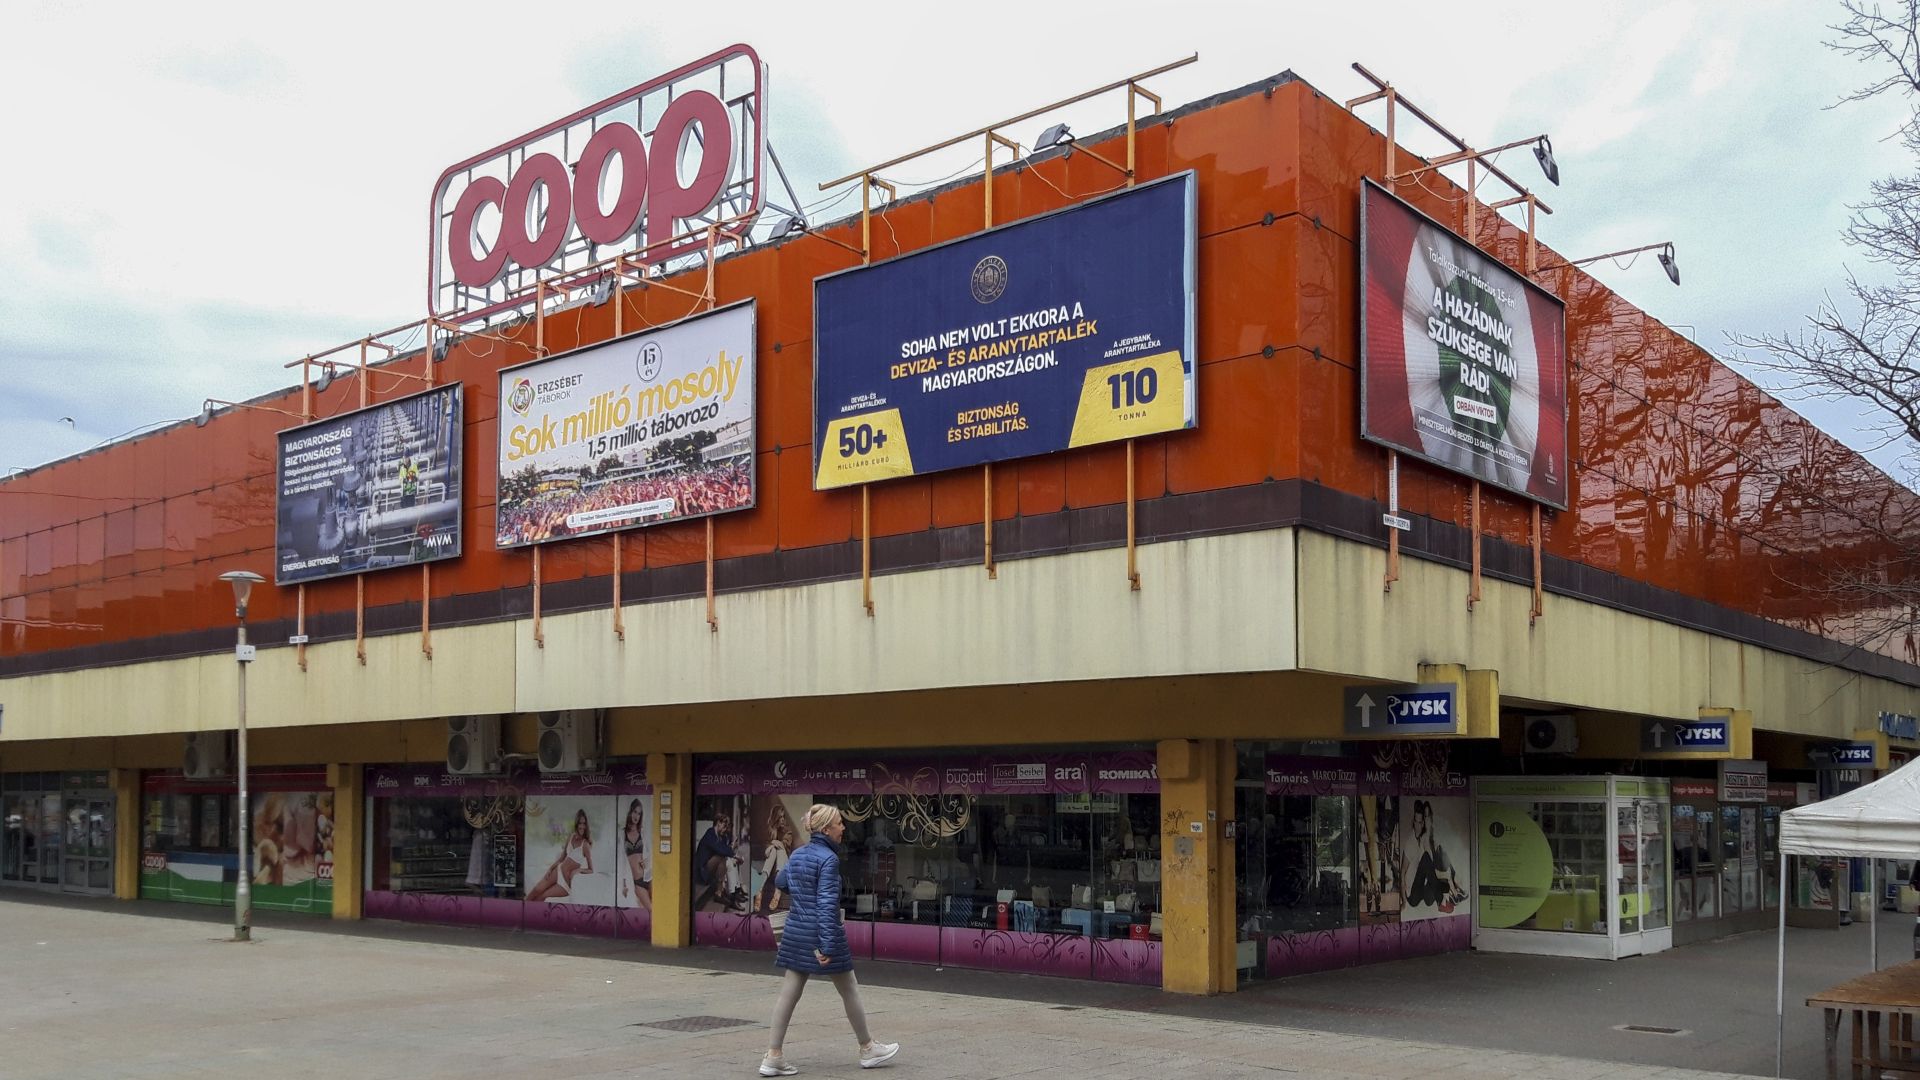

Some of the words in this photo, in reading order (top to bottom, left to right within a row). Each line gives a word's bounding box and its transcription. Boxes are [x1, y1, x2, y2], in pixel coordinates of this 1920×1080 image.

[448, 89, 735, 289] coop
[1471, 274, 1496, 297] március
[1432, 286, 1443, 311] A
[1445, 291, 1513, 348] HAZÁDNAK
[901, 338, 937, 358] SOHA
[940, 327, 969, 350] NEM
[971, 319, 1007, 342] VOLT
[1010, 305, 1069, 334] EKKORA
[1072, 301, 1084, 320] A
[1119, 333, 1152, 347] JEGYBANK
[643, 348, 656, 365] 15
[890, 359, 943, 380] DEVIZA-
[948, 349, 965, 368] ÉS
[968, 319, 1098, 363] ARANYTARTALÉK
[1103, 339, 1161, 358] ARANYTARTALÉKA
[1427, 316, 1492, 367] SZÜKSÉGE
[1493, 348, 1518, 381] VAN
[922, 350, 1059, 394] MAGYARORSZÁGON.
[1460, 361, 1490, 395] RÁD!
[537, 373, 583, 395] ERZSÉBET
[1107, 367, 1158, 410] 110
[507, 413, 557, 461] Sok
[562, 383, 632, 446] millió
[637, 350, 743, 420] mosoly
[537, 390, 571, 406] TÁBOROK
[957, 401, 1020, 425] BIZTONSÁG
[1118, 410, 1147, 421] TONNA
[1456, 400, 1476, 414] ORBÁN
[1475, 405, 1495, 419] VIKTOR
[588, 438, 606, 459] 1,5
[610, 420, 648, 450] millió
[651, 396, 720, 437] táborozó
[947, 427, 962, 442] ÉS
[963, 416, 1029, 440] STABILITÁS.
[285, 425, 353, 453] MAGYARORSZÁG
[839, 423, 888, 458] 50+
[284, 444, 342, 467] BIZTONSÁGOS
[426, 534, 453, 549] MVM
[308, 553, 340, 568] BIZTONSÁG
[1399, 699, 1448, 717] JYSK
[1684, 727, 1723, 740] JYSK
[1839, 749, 1871, 759] JYSK
[946, 767, 987, 788] bugatti
[996, 766, 1016, 778] Josef
[1019, 765, 1044, 778] Seibel
[1054, 766, 1078, 781] ara
[1098, 770, 1153, 780] ROMIKA
[1266, 768, 1309, 784] Tamaris
[1312, 769, 1337, 781] MARCO
